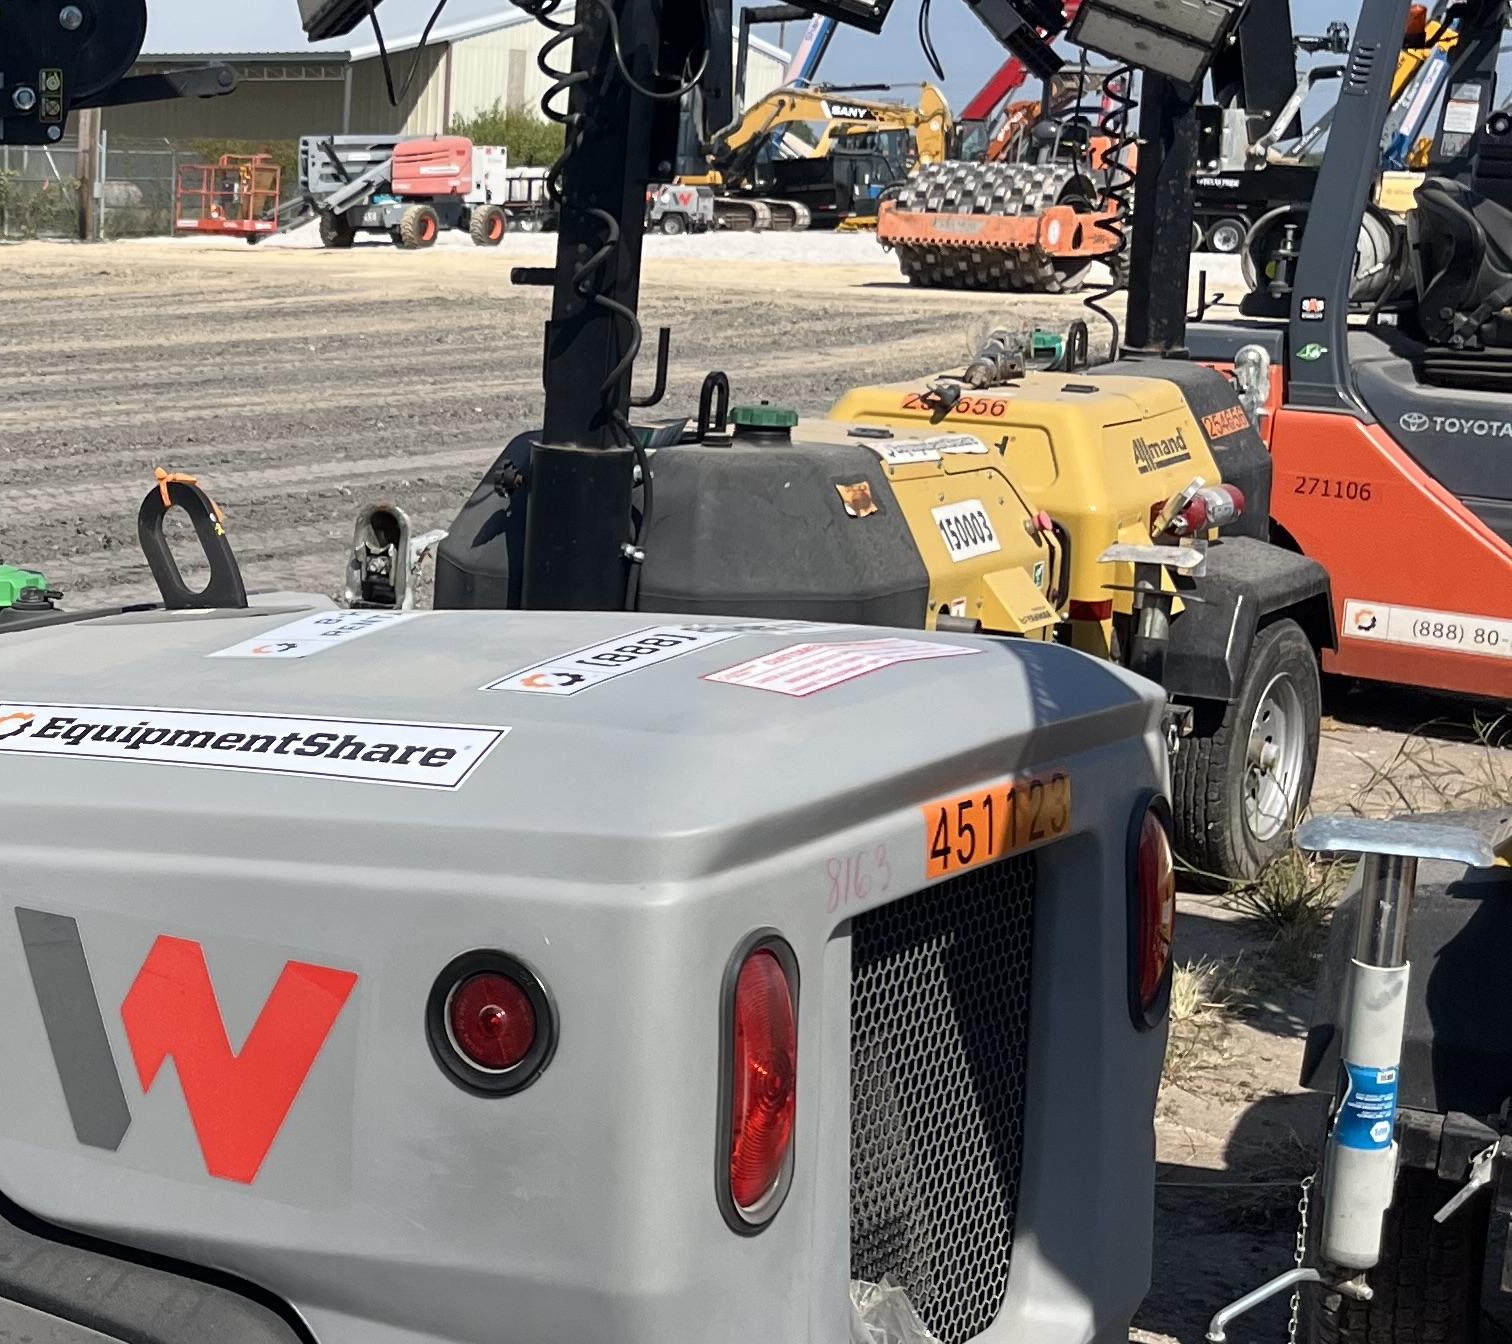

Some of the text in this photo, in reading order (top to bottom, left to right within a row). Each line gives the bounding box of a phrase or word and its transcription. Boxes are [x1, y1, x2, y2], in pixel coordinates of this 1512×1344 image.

[831, 105, 868, 119] SANY
[902, 392, 1008, 417] 2656
[1432, 416, 1512, 438] TOYOTA
[1131, 426, 1189, 471] Allmand
[1294, 475, 1372, 501] 271106
[939, 510, 993, 552] 150003
[1412, 618, 1512, 648] (888) 80-
[575, 632, 698, 667] (888)
[31, 715, 458, 769] EquipmentShare
[930, 772, 1069, 870] 451123
